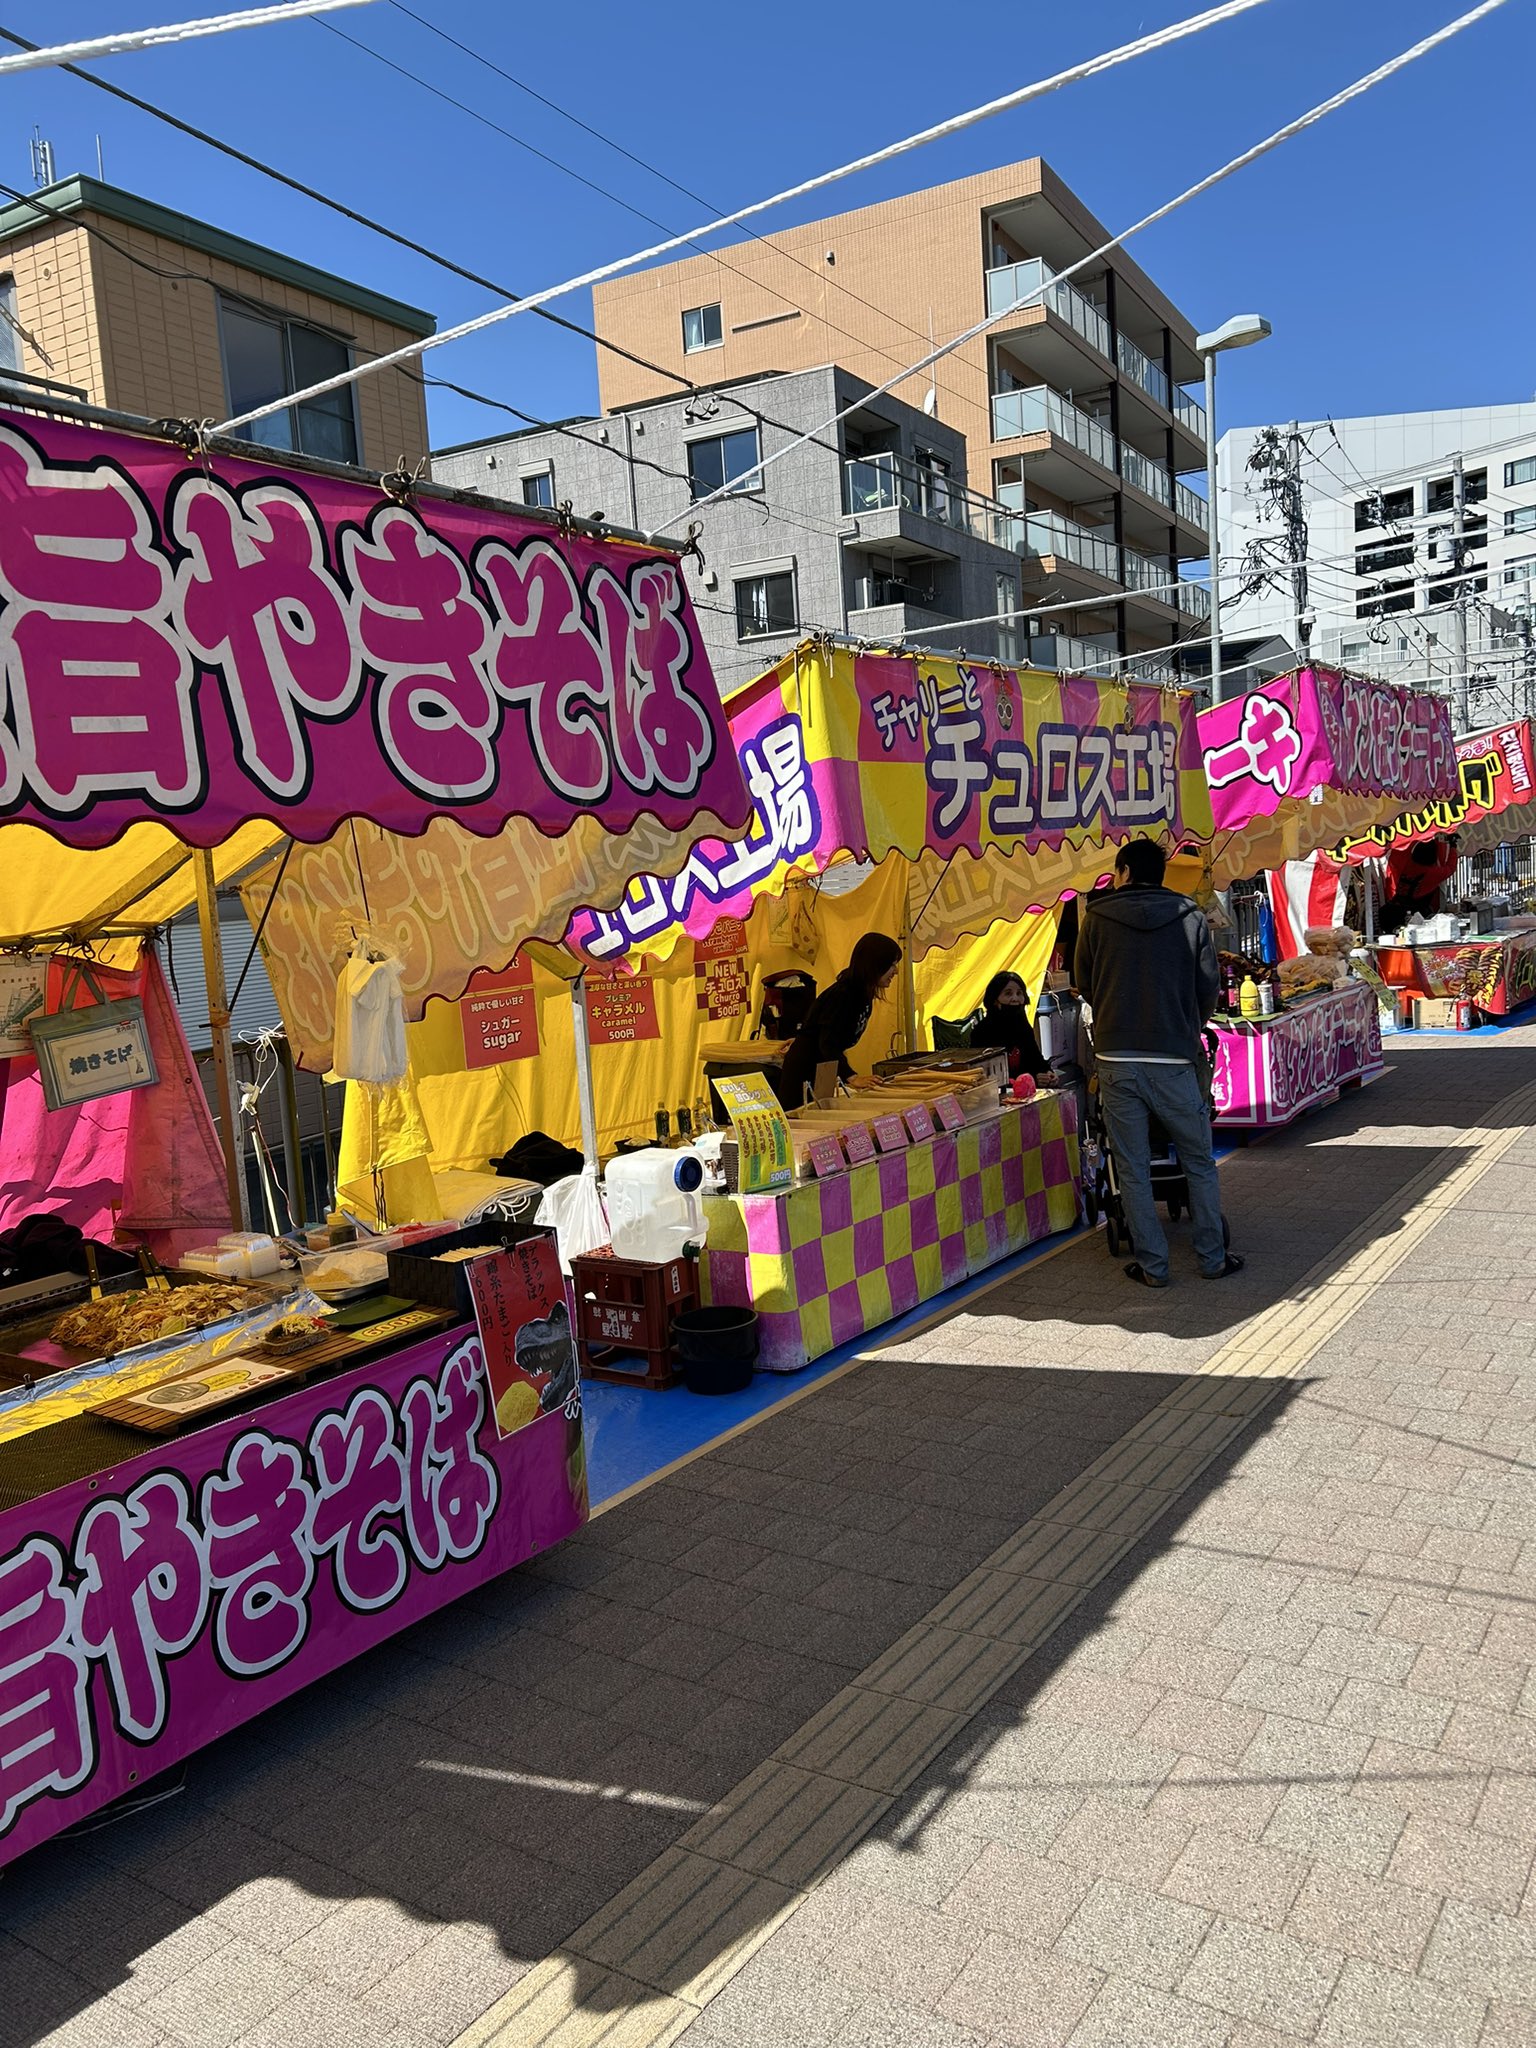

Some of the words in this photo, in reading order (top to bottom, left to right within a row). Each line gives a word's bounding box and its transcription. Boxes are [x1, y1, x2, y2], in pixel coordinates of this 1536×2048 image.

[874, 668, 982, 749] チャリーと
[931, 720, 1176, 828] チュロス工場
[715, 963, 737, 978] NEW
[706, 978, 742, 995] チュロス
[714, 992, 740, 1004] churro
[591, 1002, 646, 1019] キャラメル
[717, 1005, 740, 1017] 500円
[481, 1016, 520, 1033] シュガー
[601, 1016, 637, 1028] caramel
[483, 1031, 521, 1049] sugar
[608, 1028, 635, 1040] 500円
[69, 1043, 133, 1076] 焼きそば
[769, 1168, 792, 1183] 500円
[518, 1246, 538, 1301] 焼きそば
[475, 1276, 493, 1332] 600円
